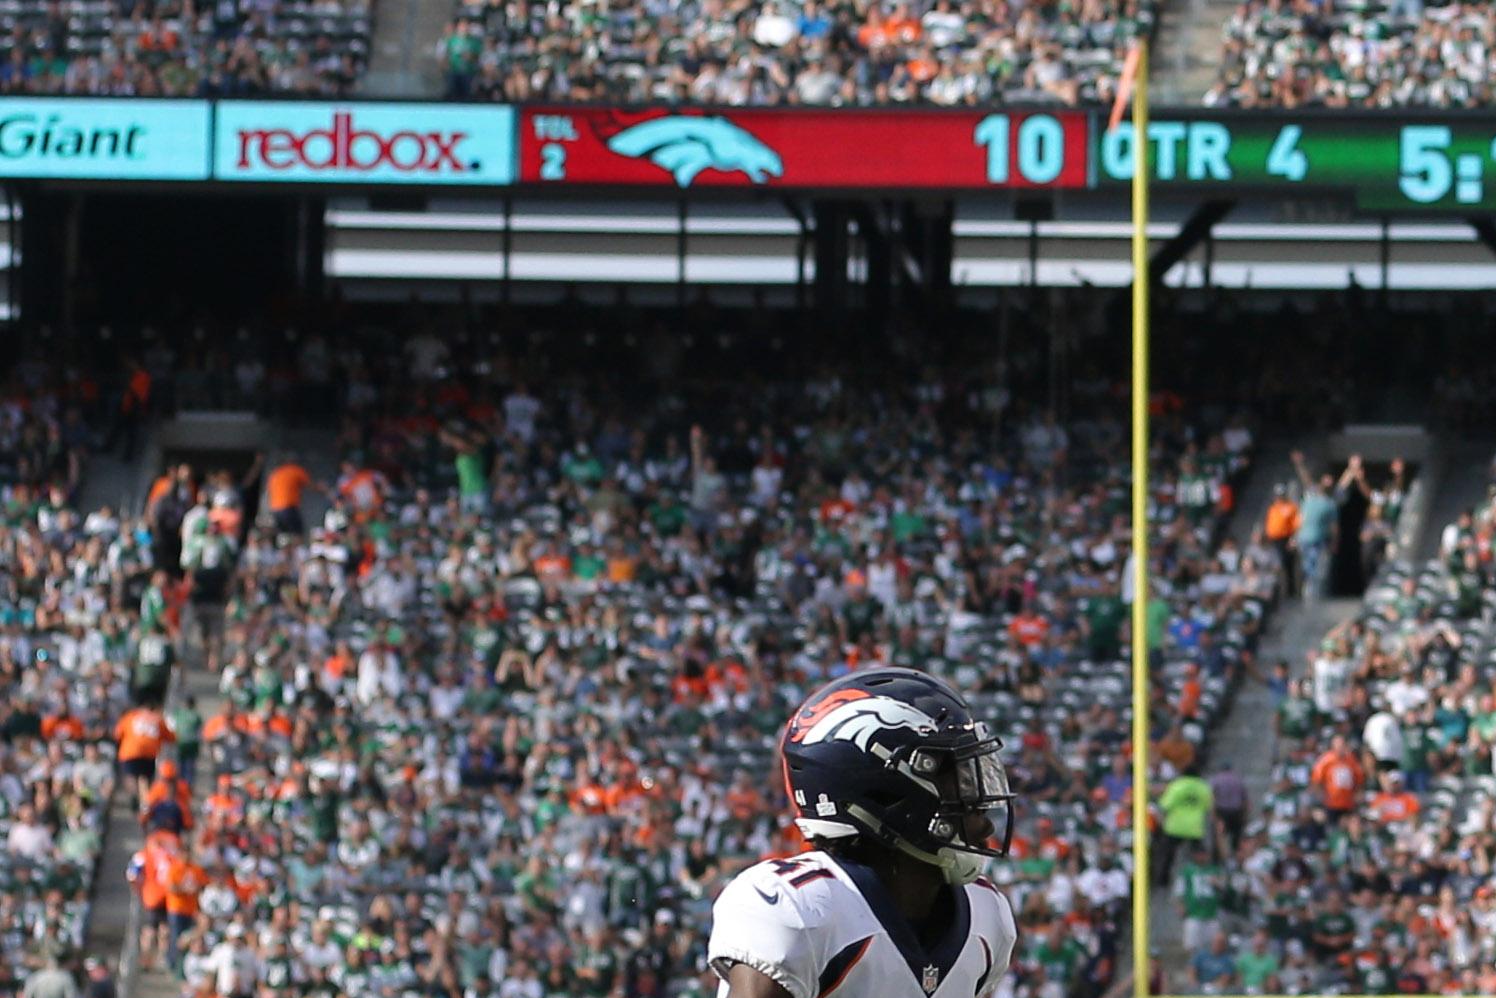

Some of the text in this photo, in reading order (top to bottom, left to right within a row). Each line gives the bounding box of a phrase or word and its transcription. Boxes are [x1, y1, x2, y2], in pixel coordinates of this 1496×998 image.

[0, 112, 147, 158] Giant
[973, 113, 1065, 184] 10
[1266, 123, 1308, 181] 4
[541, 143, 566, 180] 2
